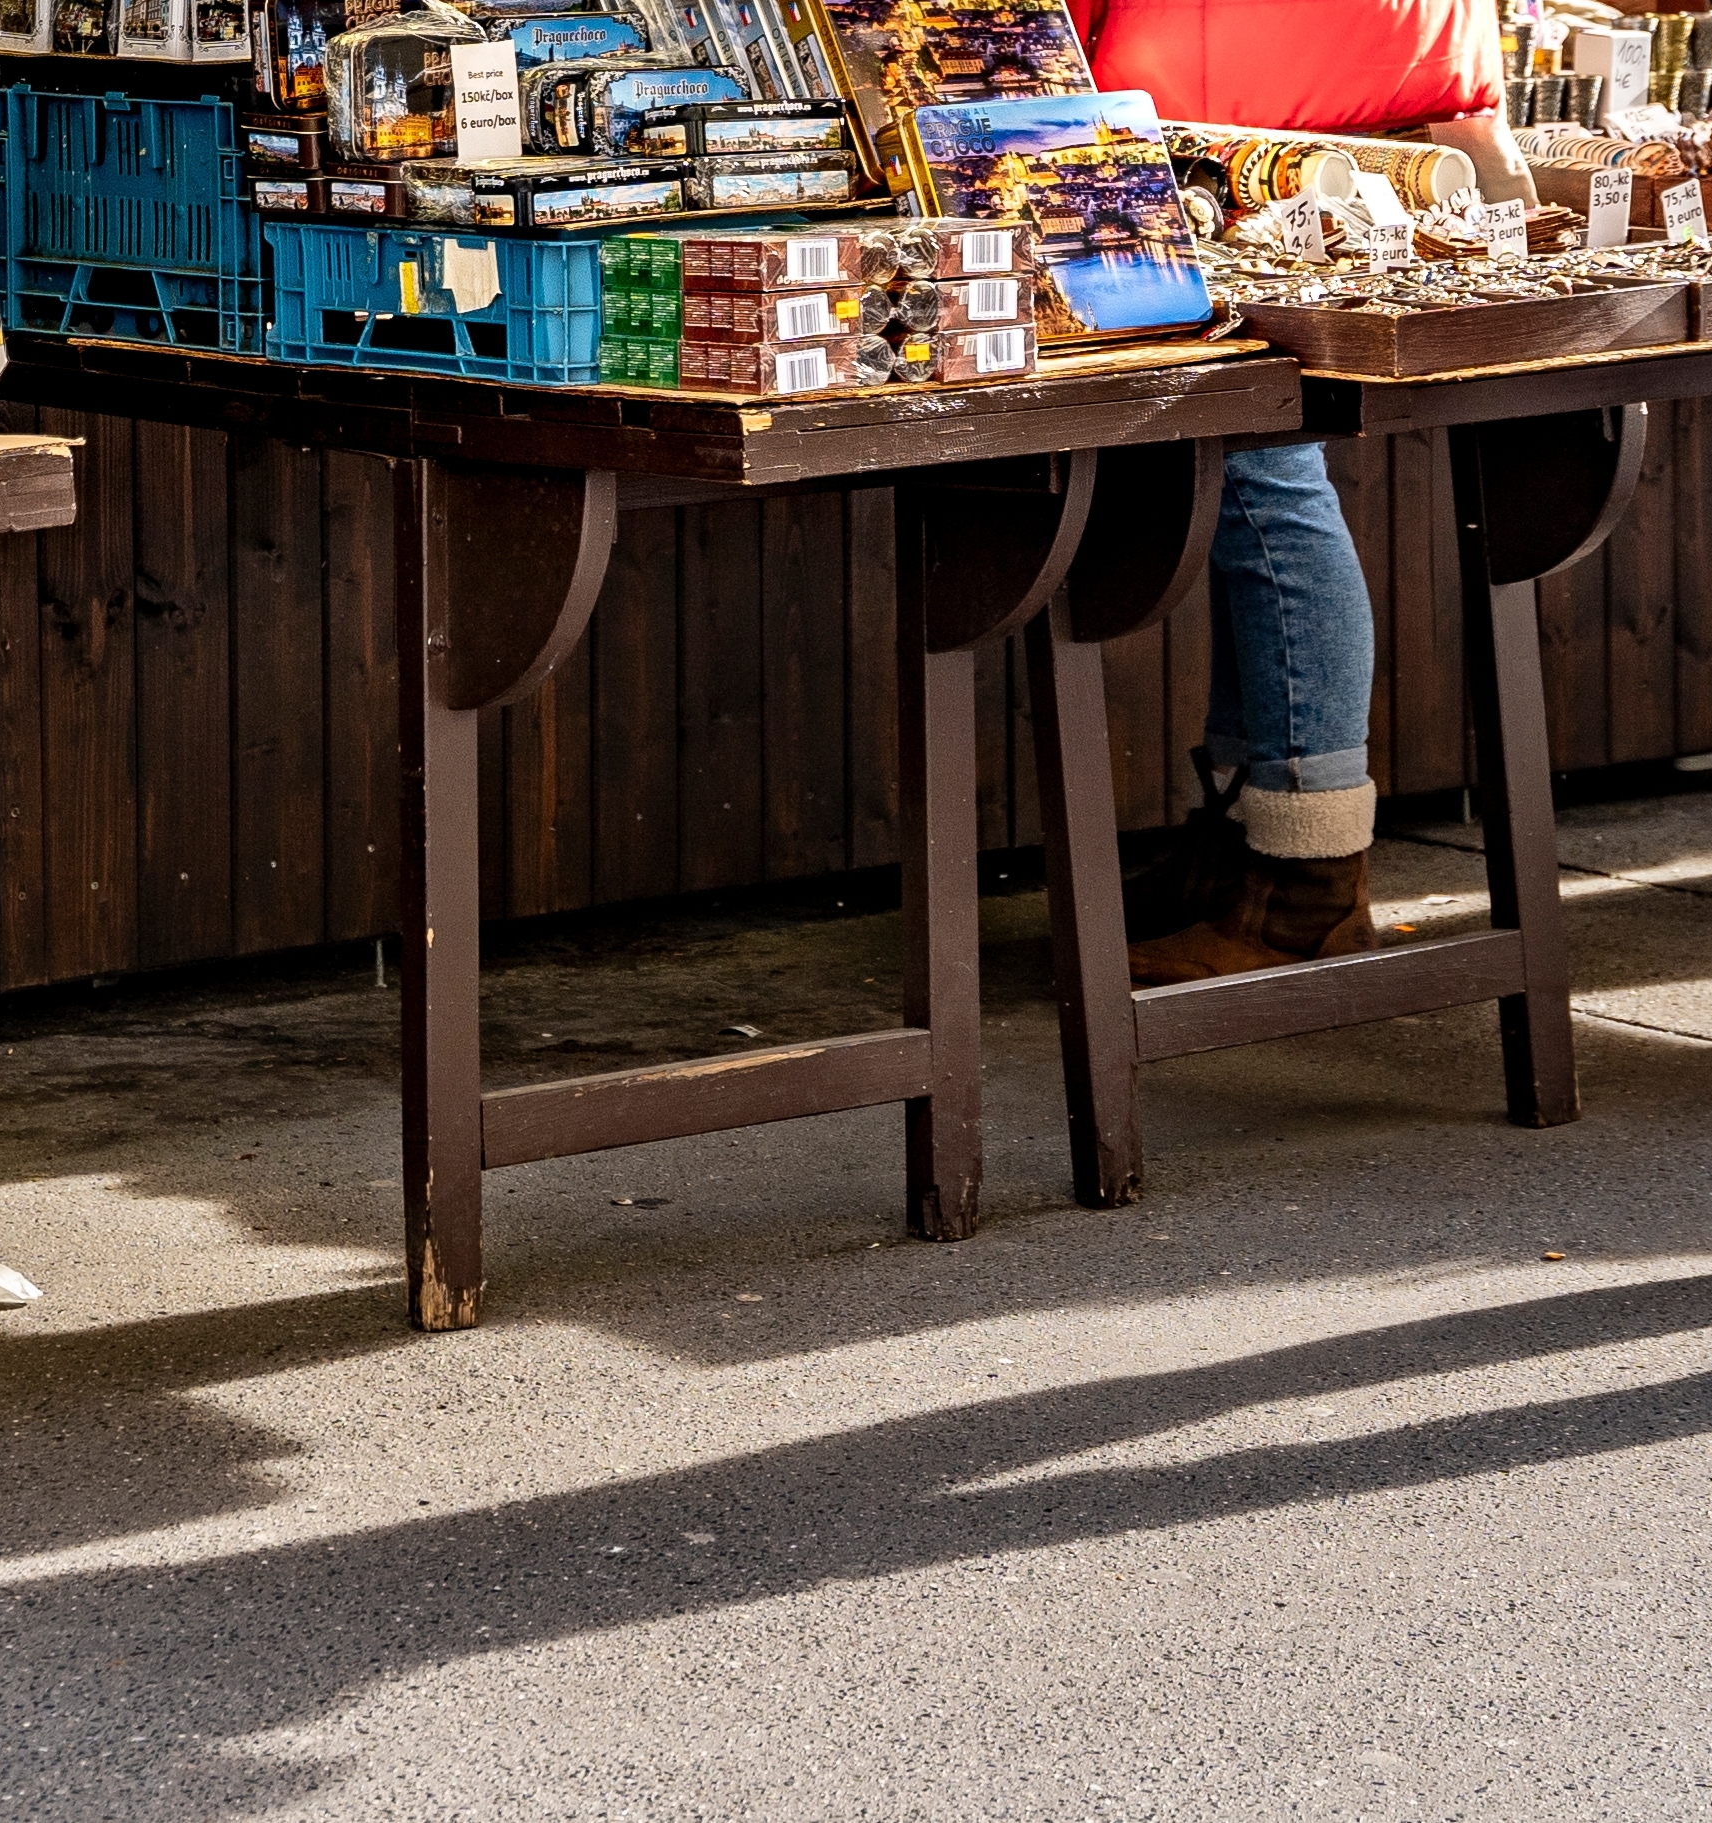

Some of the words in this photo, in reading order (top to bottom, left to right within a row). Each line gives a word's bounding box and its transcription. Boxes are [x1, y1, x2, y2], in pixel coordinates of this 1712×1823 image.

[467, 70, 485, 80] Best
[485, 68, 504, 80] price
[461, 88, 514, 105] 150kč/box
[460, 115, 468, 129] 6
[469, 113, 517, 130] euro/box
[924, 117, 991, 140] PRAGUE
[930, 136, 996, 158] CHOCO
[1593, 172, 1631, 190] 80,-kč
[1592, 191, 1620, 209] 3,50
[1663, 183, 1699, 208] 75,-kč
[1486, 204, 1522, 224] 75,-kč
[1668, 215, 1675, 228] 3
[1676, 206, 1703, 225] euro
[1372, 227, 1408, 243] 75,-kč
[1488, 228, 1496, 242] 3
[1498, 226, 1525, 241] euro
[1372, 249, 1379, 262] 3
[1381, 248, 1408, 262] euro
